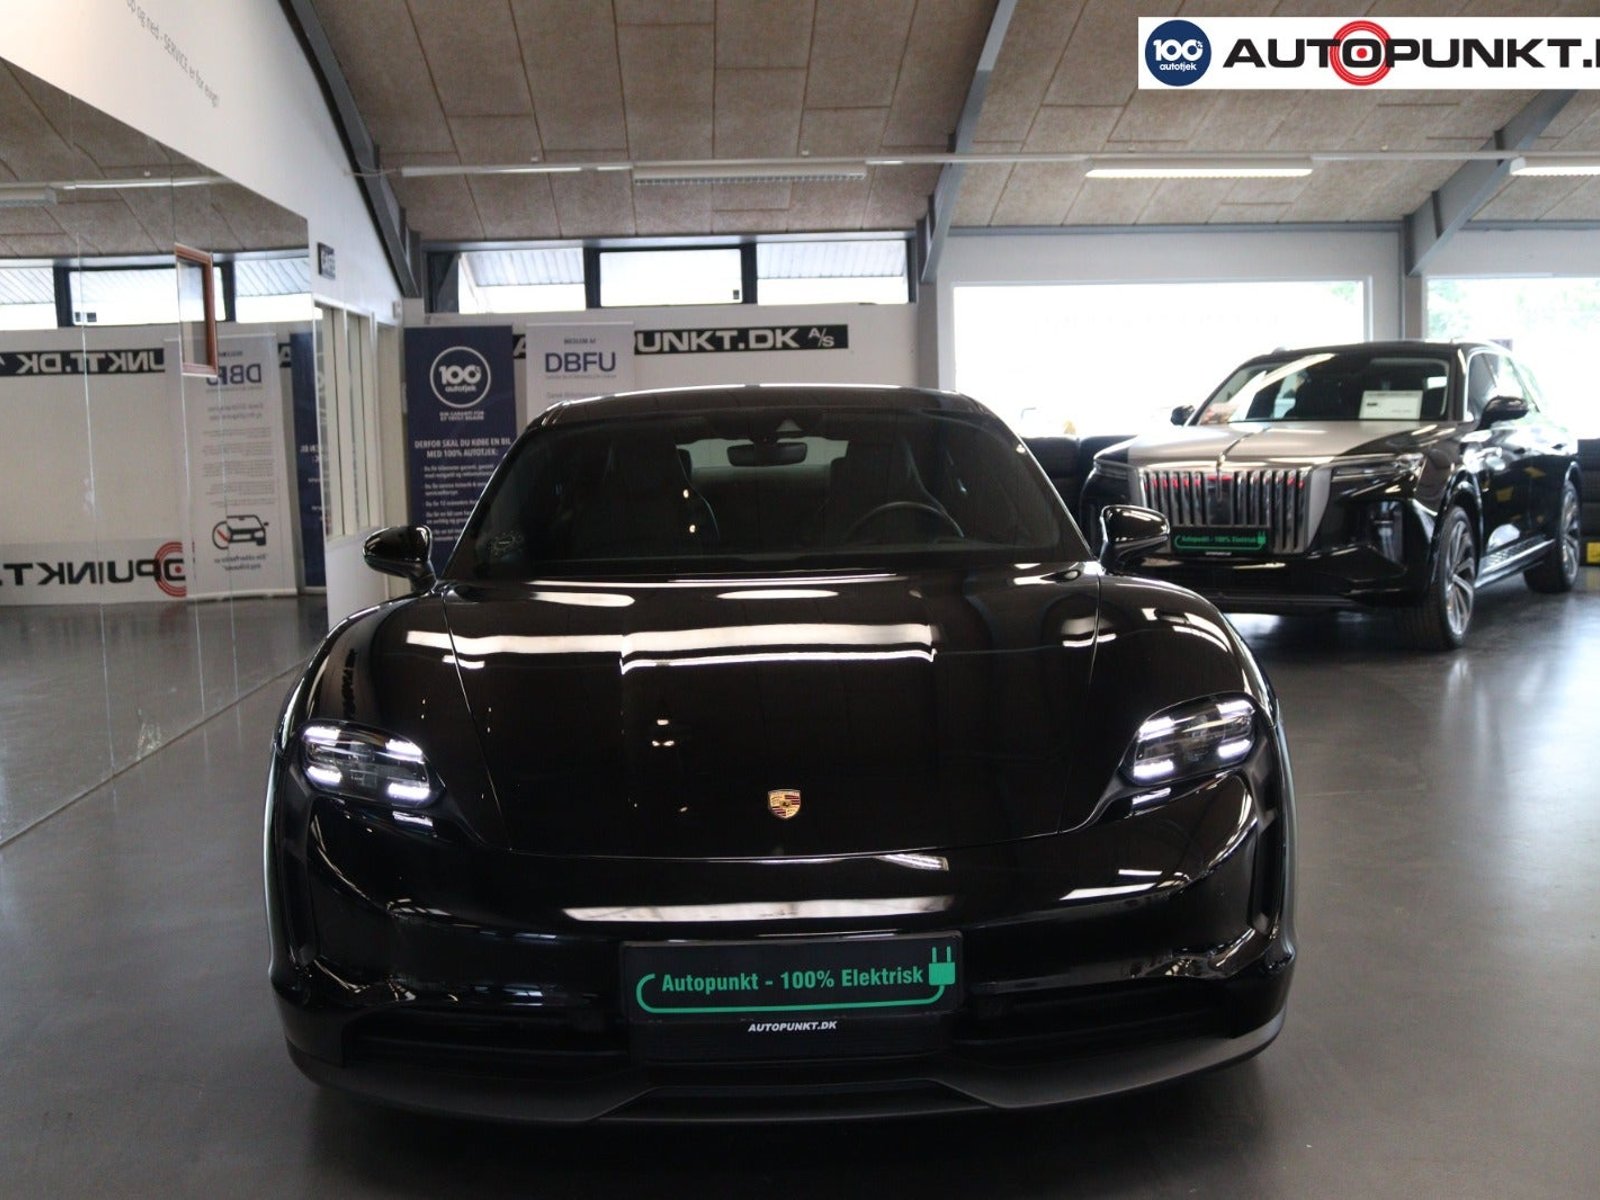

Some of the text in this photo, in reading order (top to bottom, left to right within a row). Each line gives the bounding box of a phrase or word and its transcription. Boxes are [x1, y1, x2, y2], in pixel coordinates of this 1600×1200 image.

[636, 327, 835, 352] UNKT.DK A/S
[545, 352, 616, 372] DBFU
[414, 437, 511, 448] DERFOR SKAL DU KØBE EN BIL
[427, 450, 442, 458] MED
[444, 449, 463, 457] 100%
[662, 972, 759, 995] Autopunkt
[780, 970, 835, 989] 100%
[841, 966, 923, 987] Elektrisk
[747, 1021, 838, 1033] AUTOPUNKT.DK
